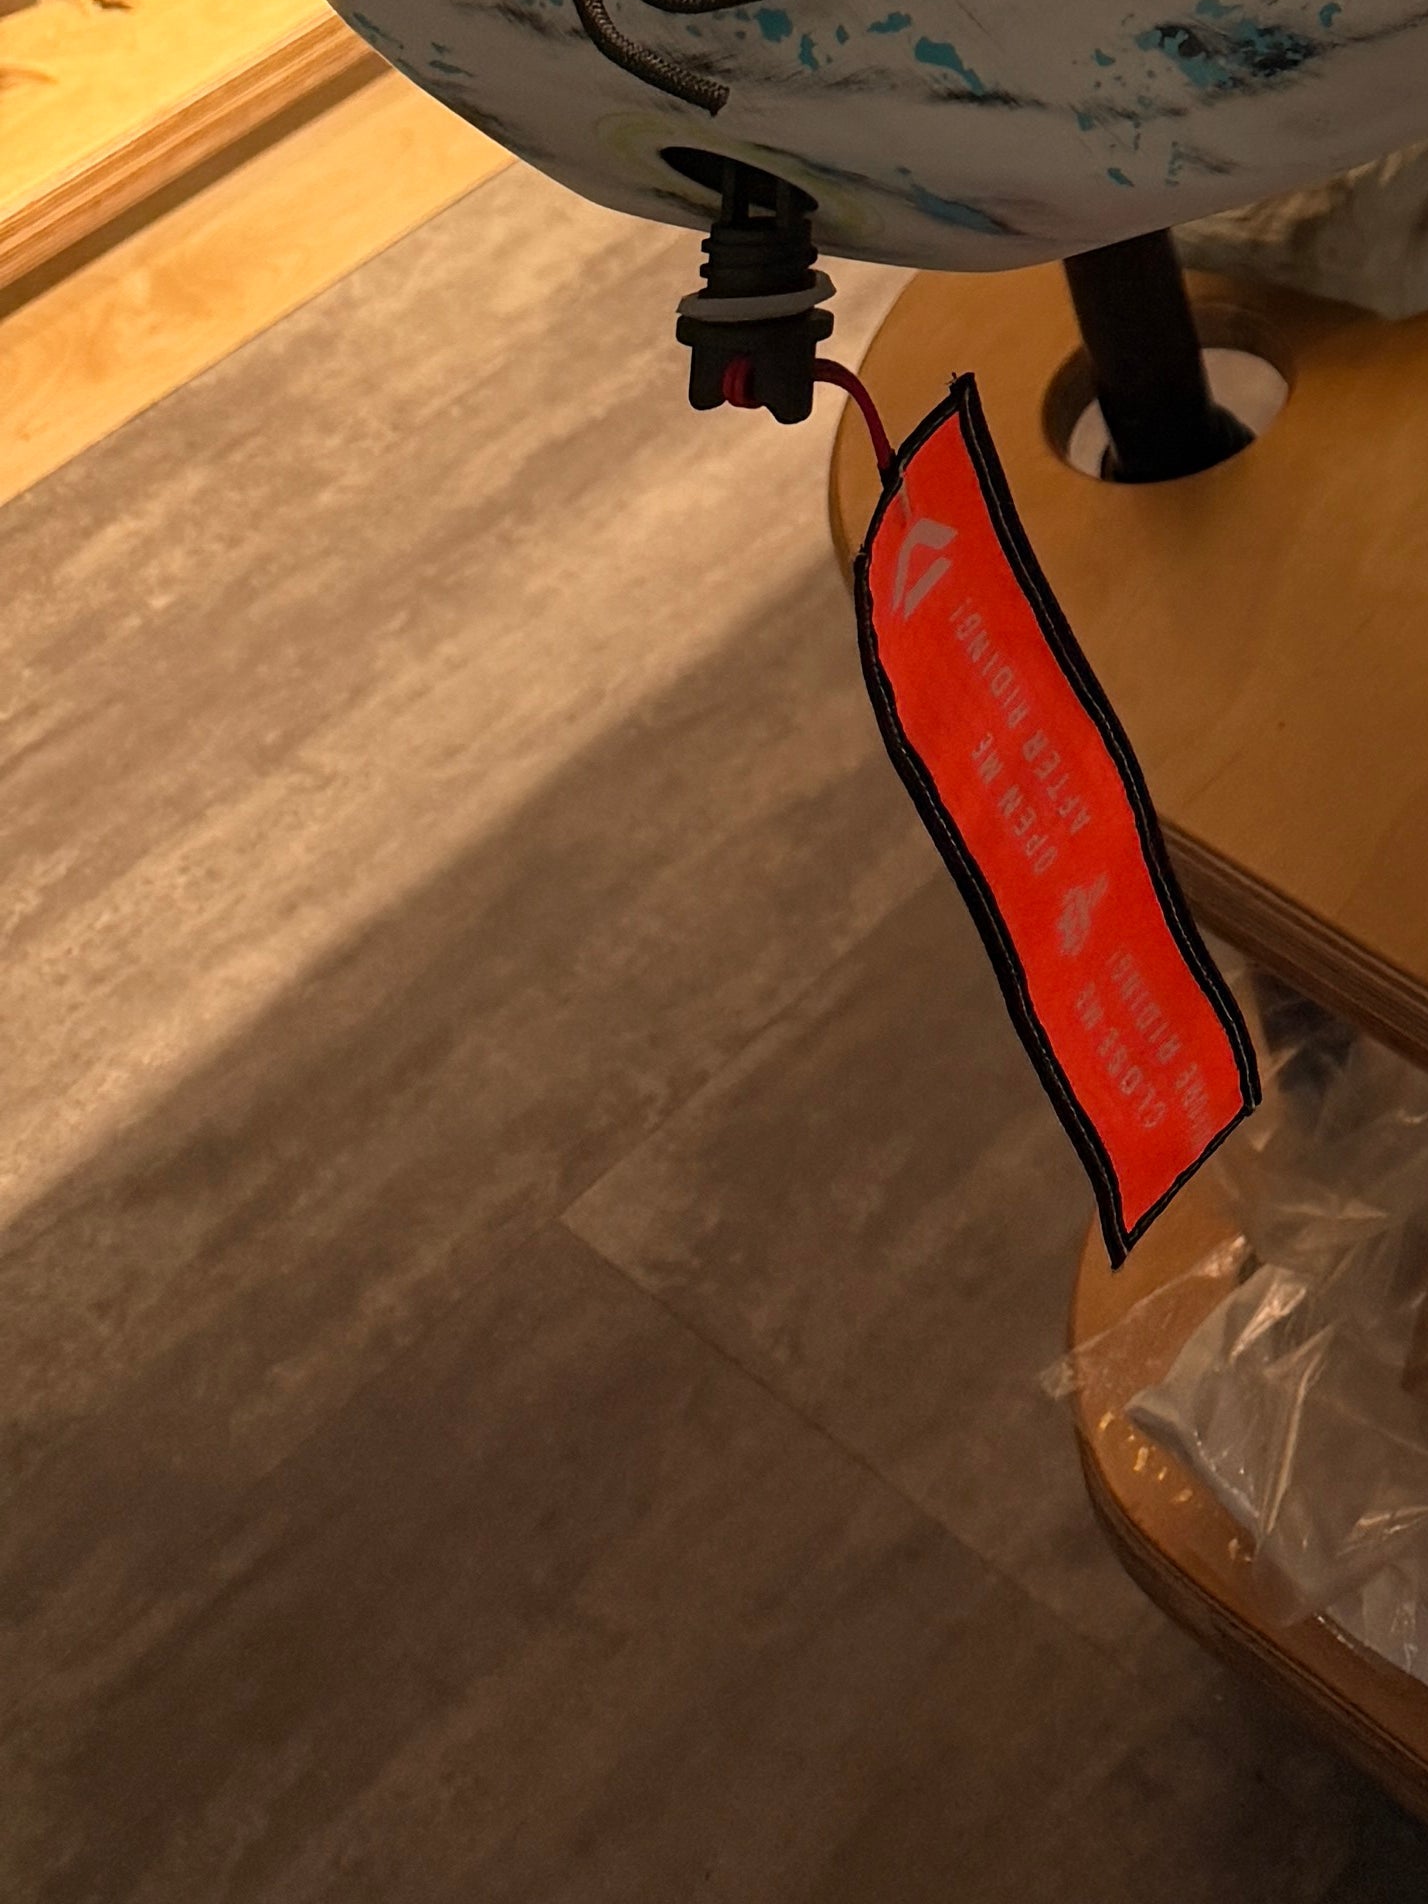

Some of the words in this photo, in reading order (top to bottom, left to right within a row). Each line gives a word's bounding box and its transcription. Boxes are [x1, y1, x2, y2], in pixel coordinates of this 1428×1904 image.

[949, 597, 1030, 729] RIDING!
[970, 732, 1003, 785] ME
[1022, 730, 1092, 835] AFTER
[999, 784, 1058, 876] OPEN
[1097, 1026, 1167, 1129] CLOSE
